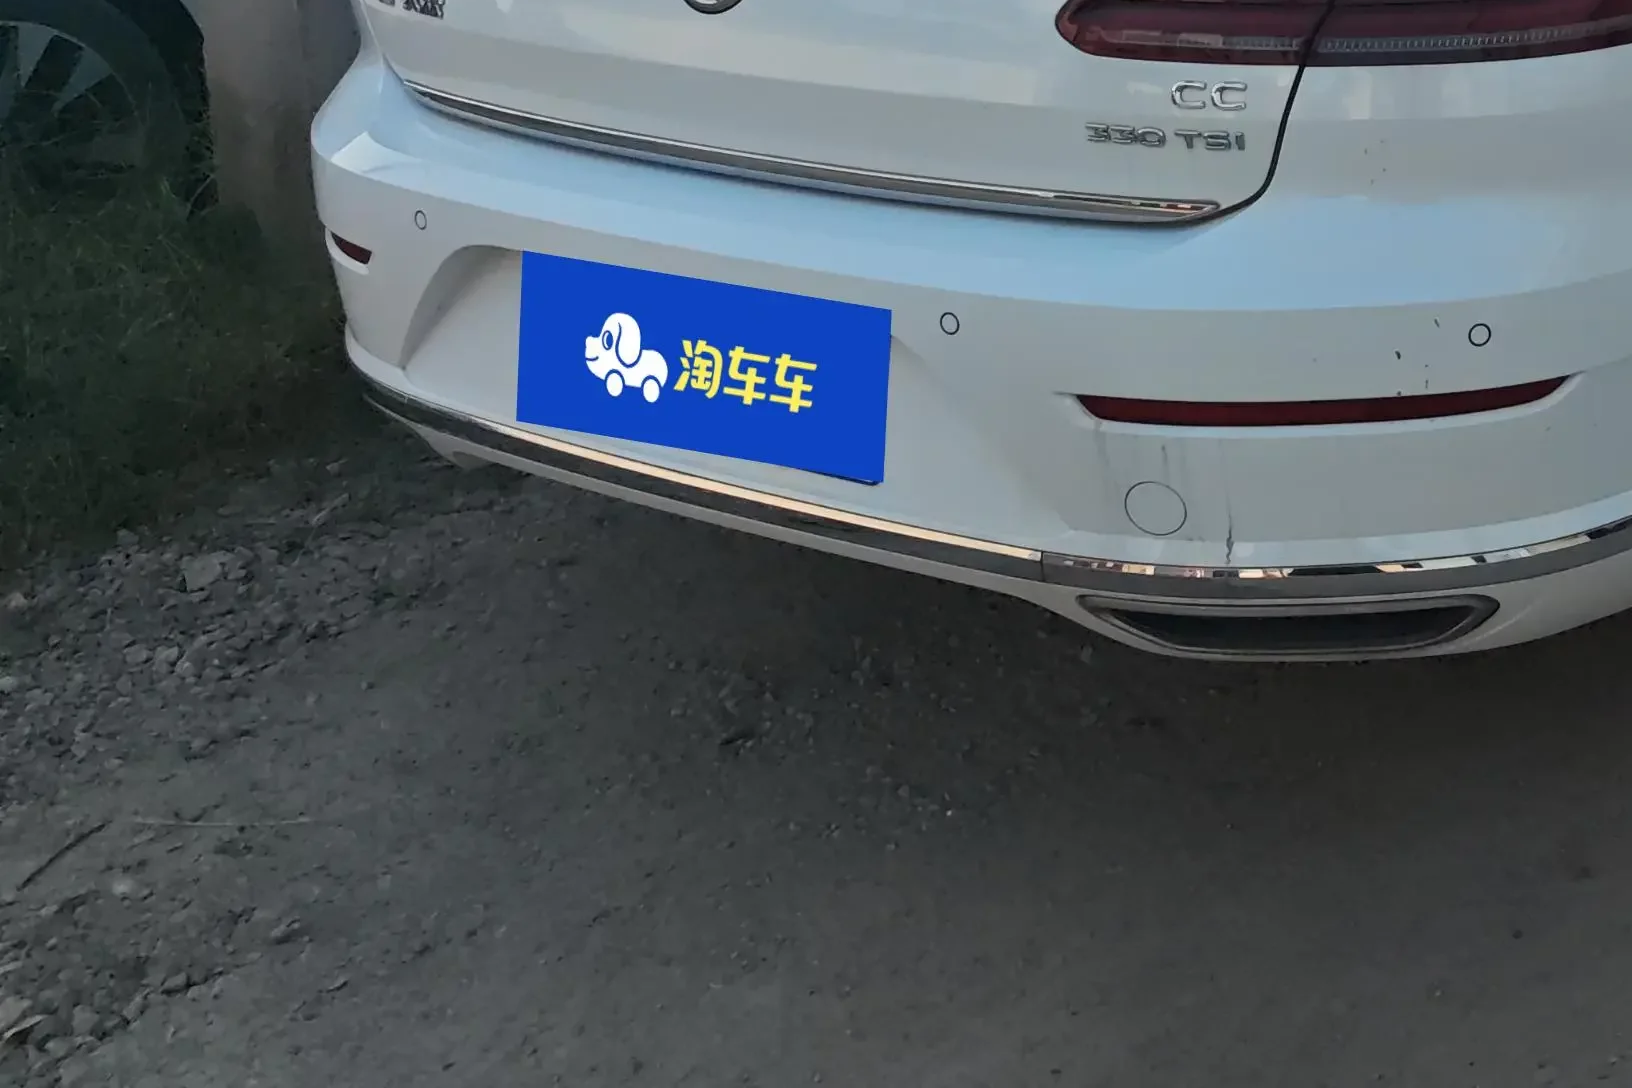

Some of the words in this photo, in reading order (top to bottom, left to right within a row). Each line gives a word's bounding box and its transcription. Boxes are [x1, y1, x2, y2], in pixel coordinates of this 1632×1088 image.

[1171, 80, 1248, 112] CC
[1085, 122, 1167, 148] 330
[1174, 129, 1246, 152] TSI
